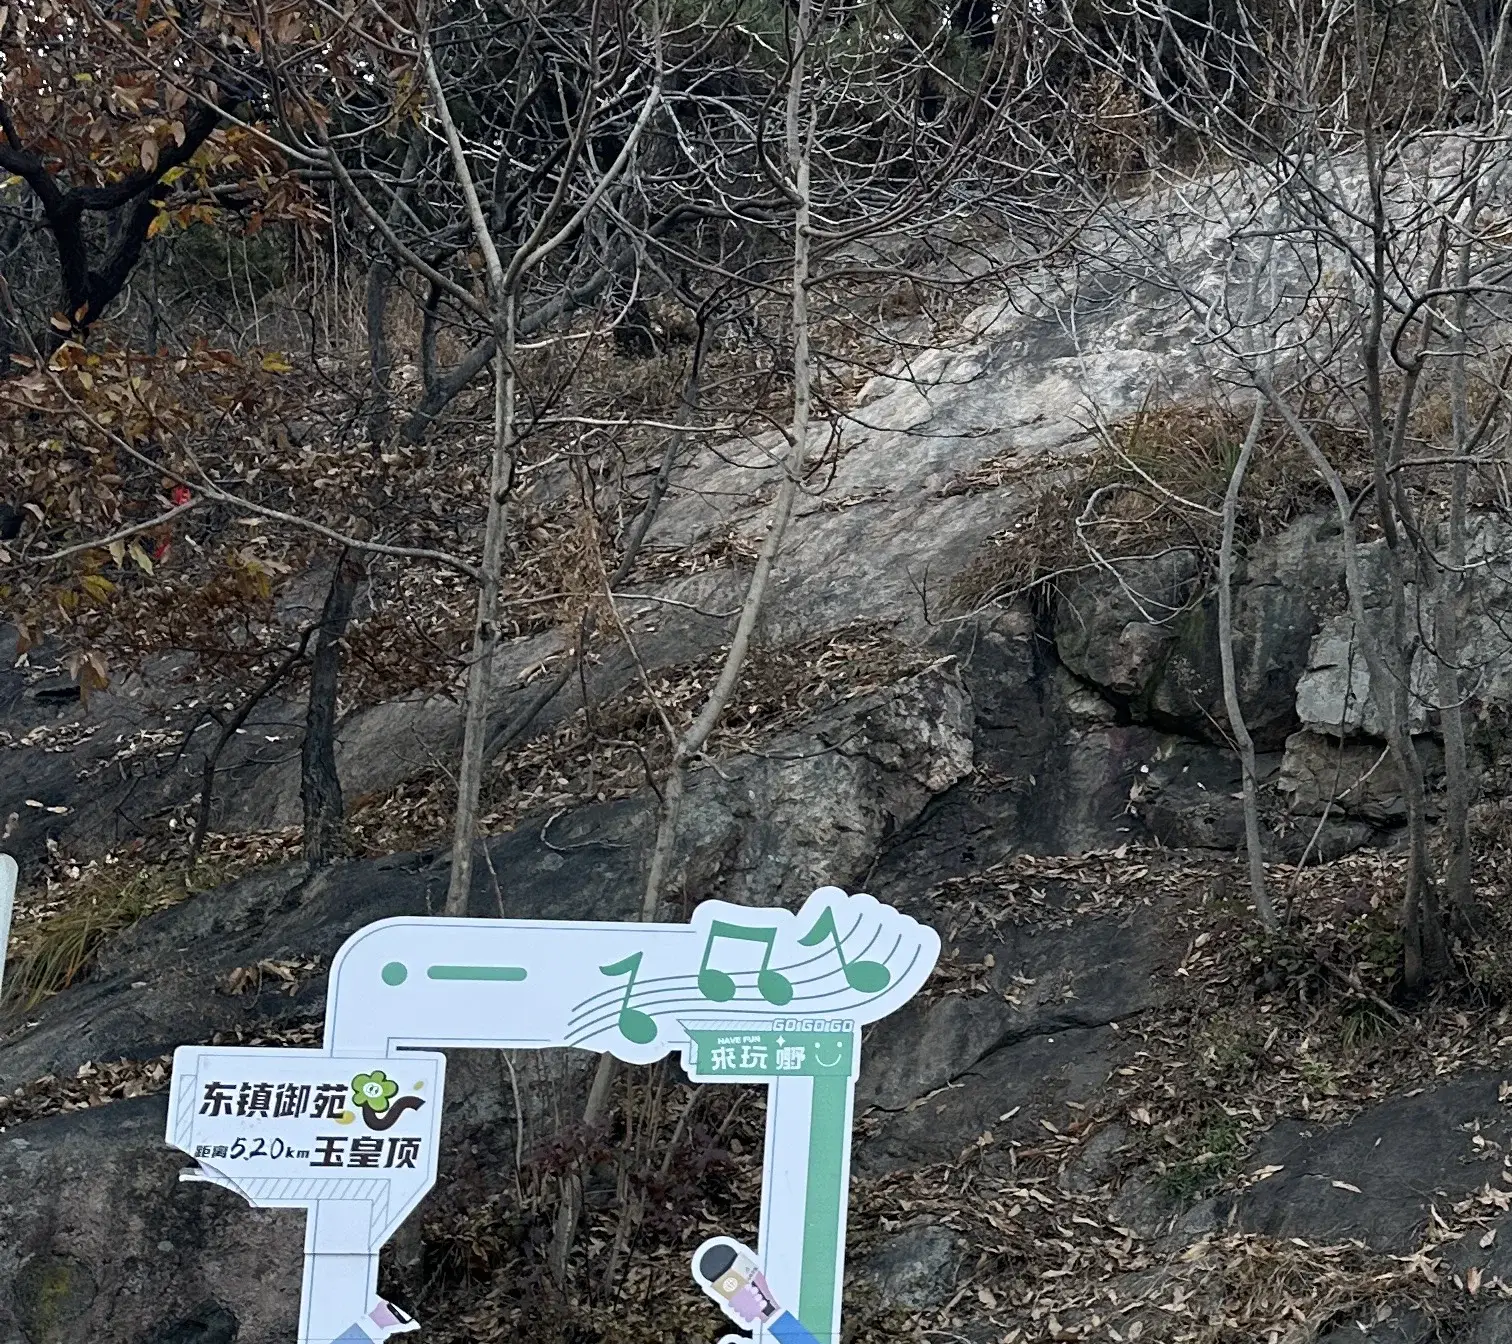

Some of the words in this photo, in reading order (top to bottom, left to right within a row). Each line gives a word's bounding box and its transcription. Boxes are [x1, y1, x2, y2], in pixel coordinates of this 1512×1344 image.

[717, 1036, 741, 1045] HAVE
[743, 1035, 761, 1044] FUN
[198, 1081, 349, 1119] 东镇御苑
[309, 1135, 422, 1169] 玉皇顶
